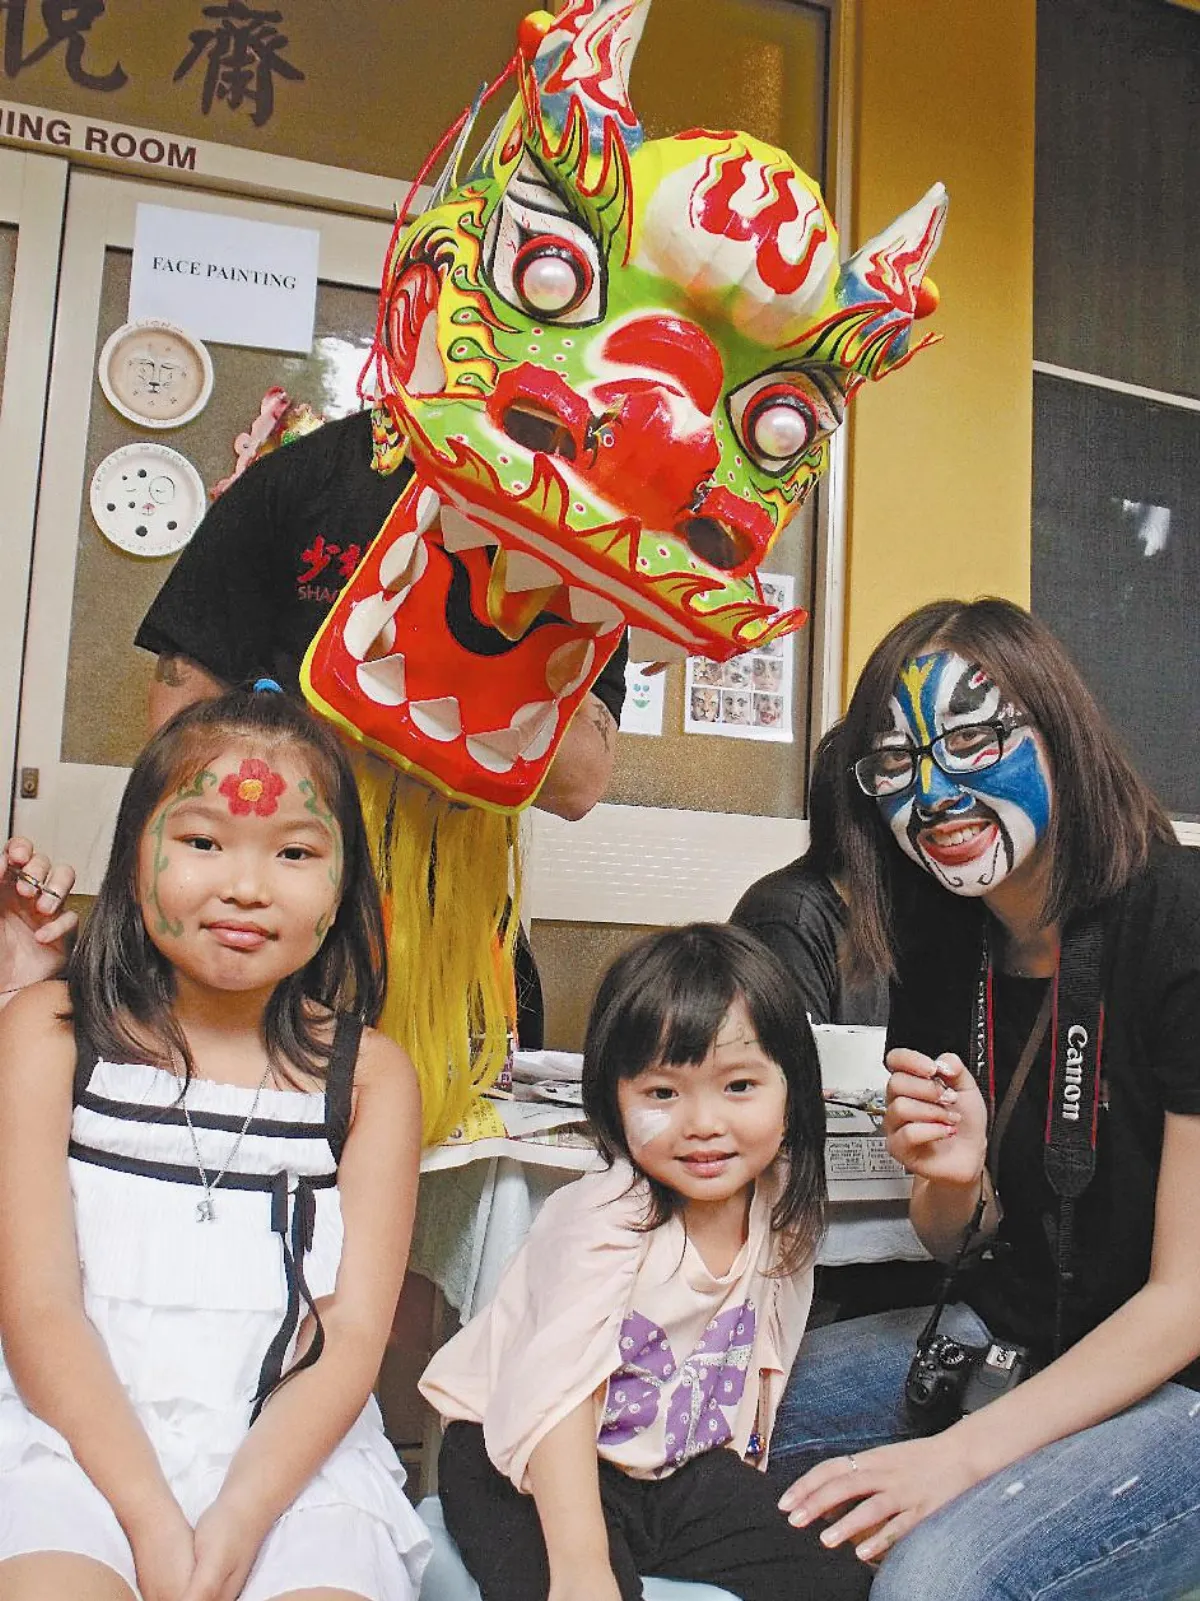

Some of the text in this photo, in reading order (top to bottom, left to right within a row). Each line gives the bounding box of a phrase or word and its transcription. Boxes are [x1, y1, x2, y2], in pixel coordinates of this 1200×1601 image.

[0, 108, 197, 170] ING ROOM
[152, 256, 297, 290] FACE PAINTING
[1062, 1024, 1088, 1121] Canon
